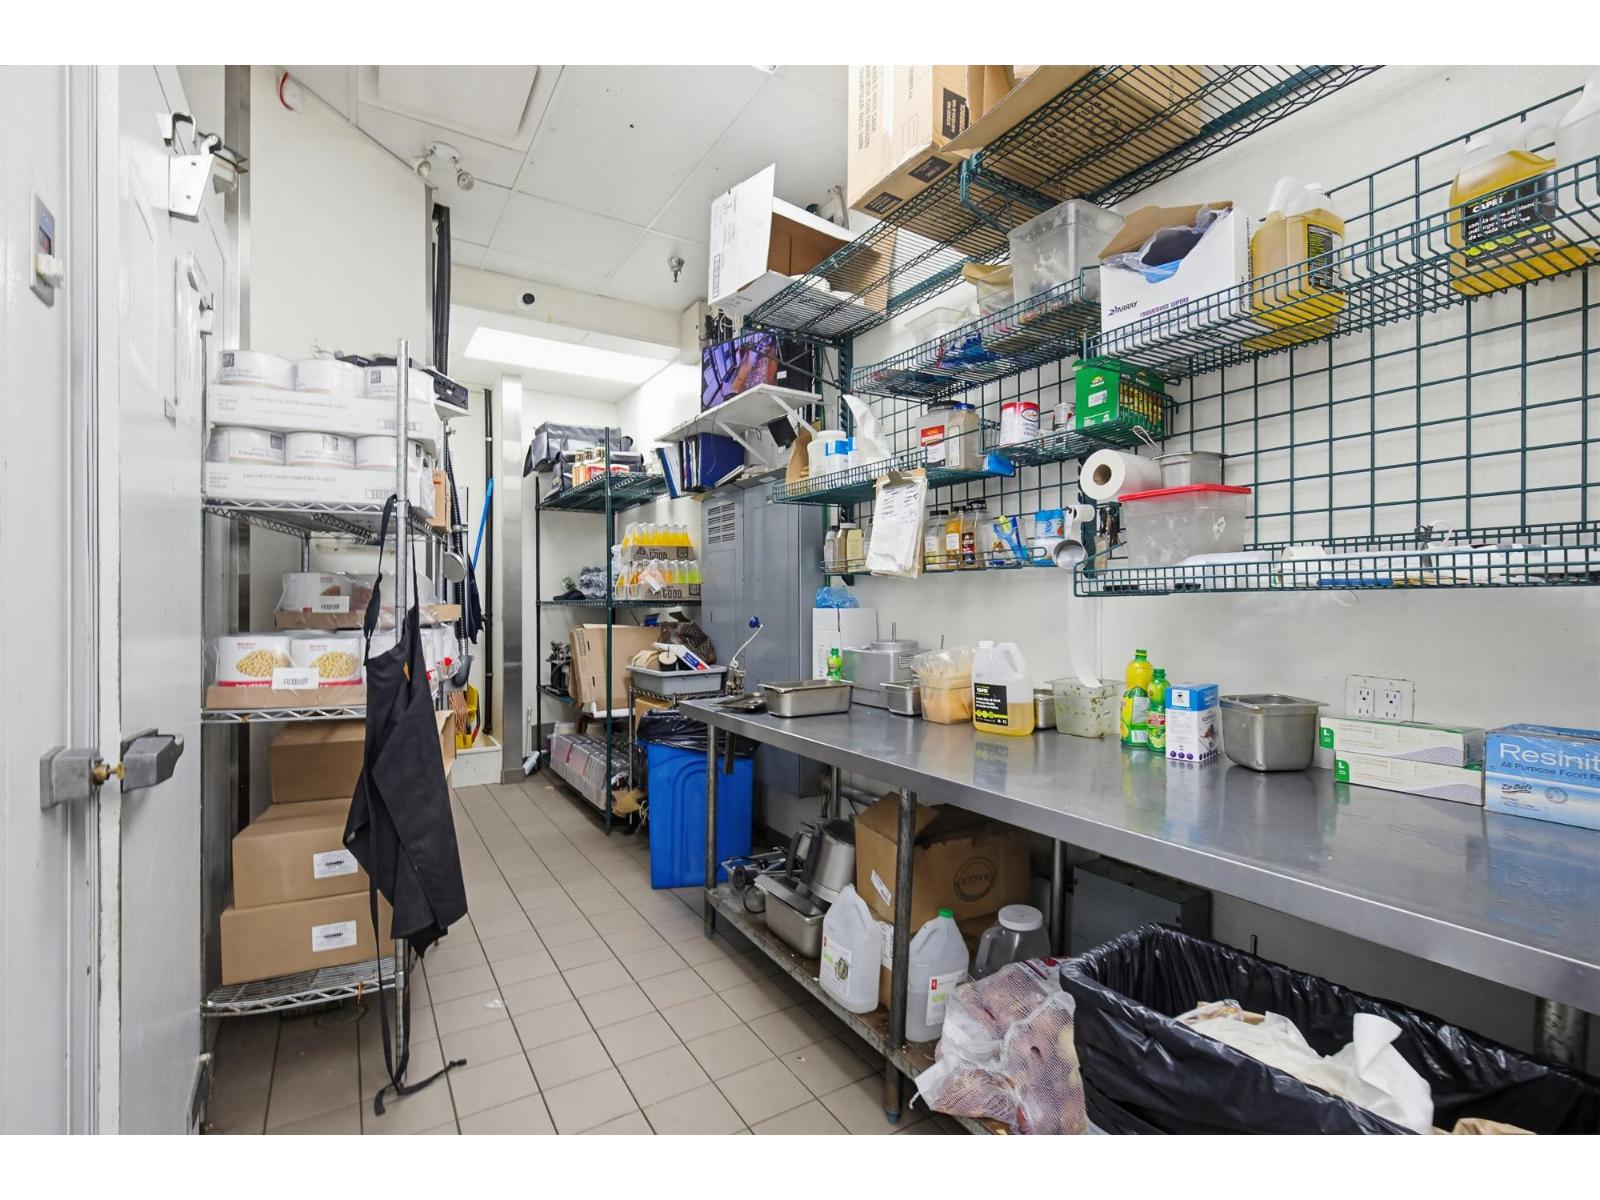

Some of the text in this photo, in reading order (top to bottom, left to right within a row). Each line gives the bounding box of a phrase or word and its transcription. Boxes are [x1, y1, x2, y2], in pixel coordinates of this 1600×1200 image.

[1117, 301, 1138, 313] ARRAY
[1515, 763, 1557, 775] Purpose
[1559, 769, 1587, 780] Food
